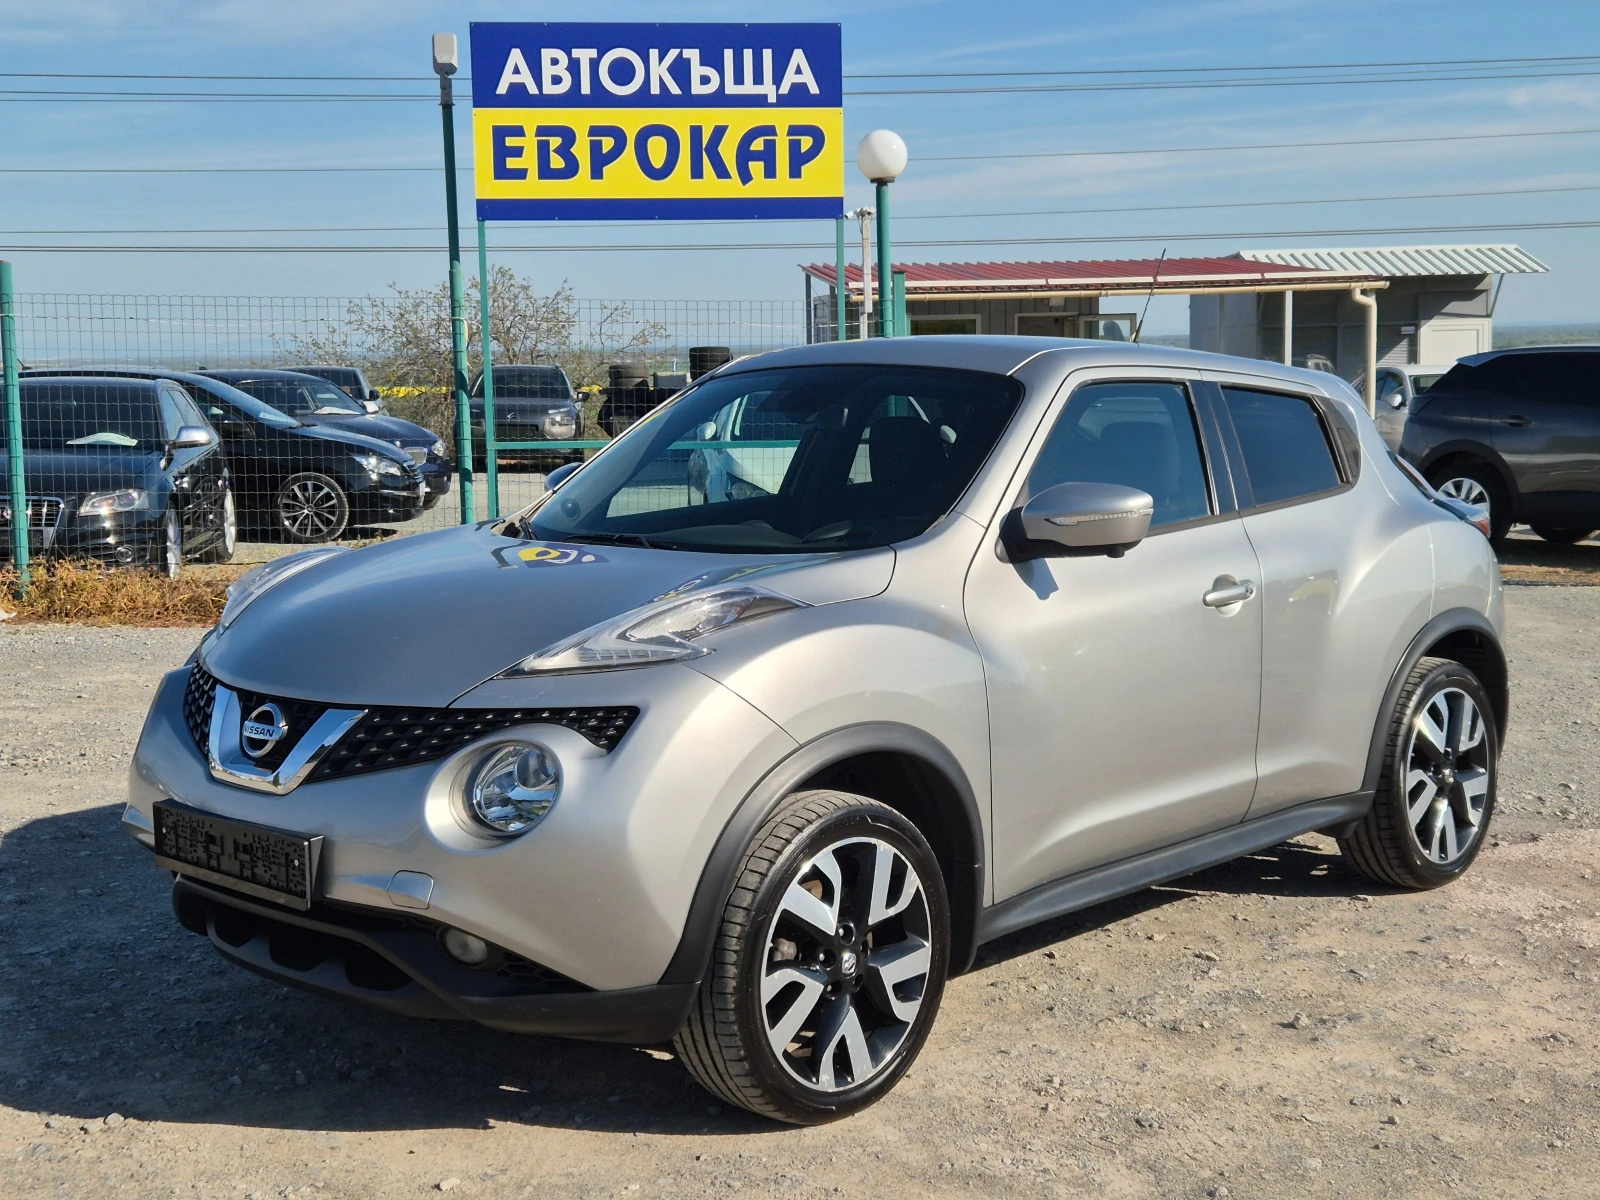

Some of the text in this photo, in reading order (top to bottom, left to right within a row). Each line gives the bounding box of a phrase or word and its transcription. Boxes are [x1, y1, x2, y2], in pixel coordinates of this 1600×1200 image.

[496, 48, 820, 103] АВТОКЪЩА
[492, 124, 826, 187] ЕВРОКАР
[243, 724, 275, 738] NISSAN
